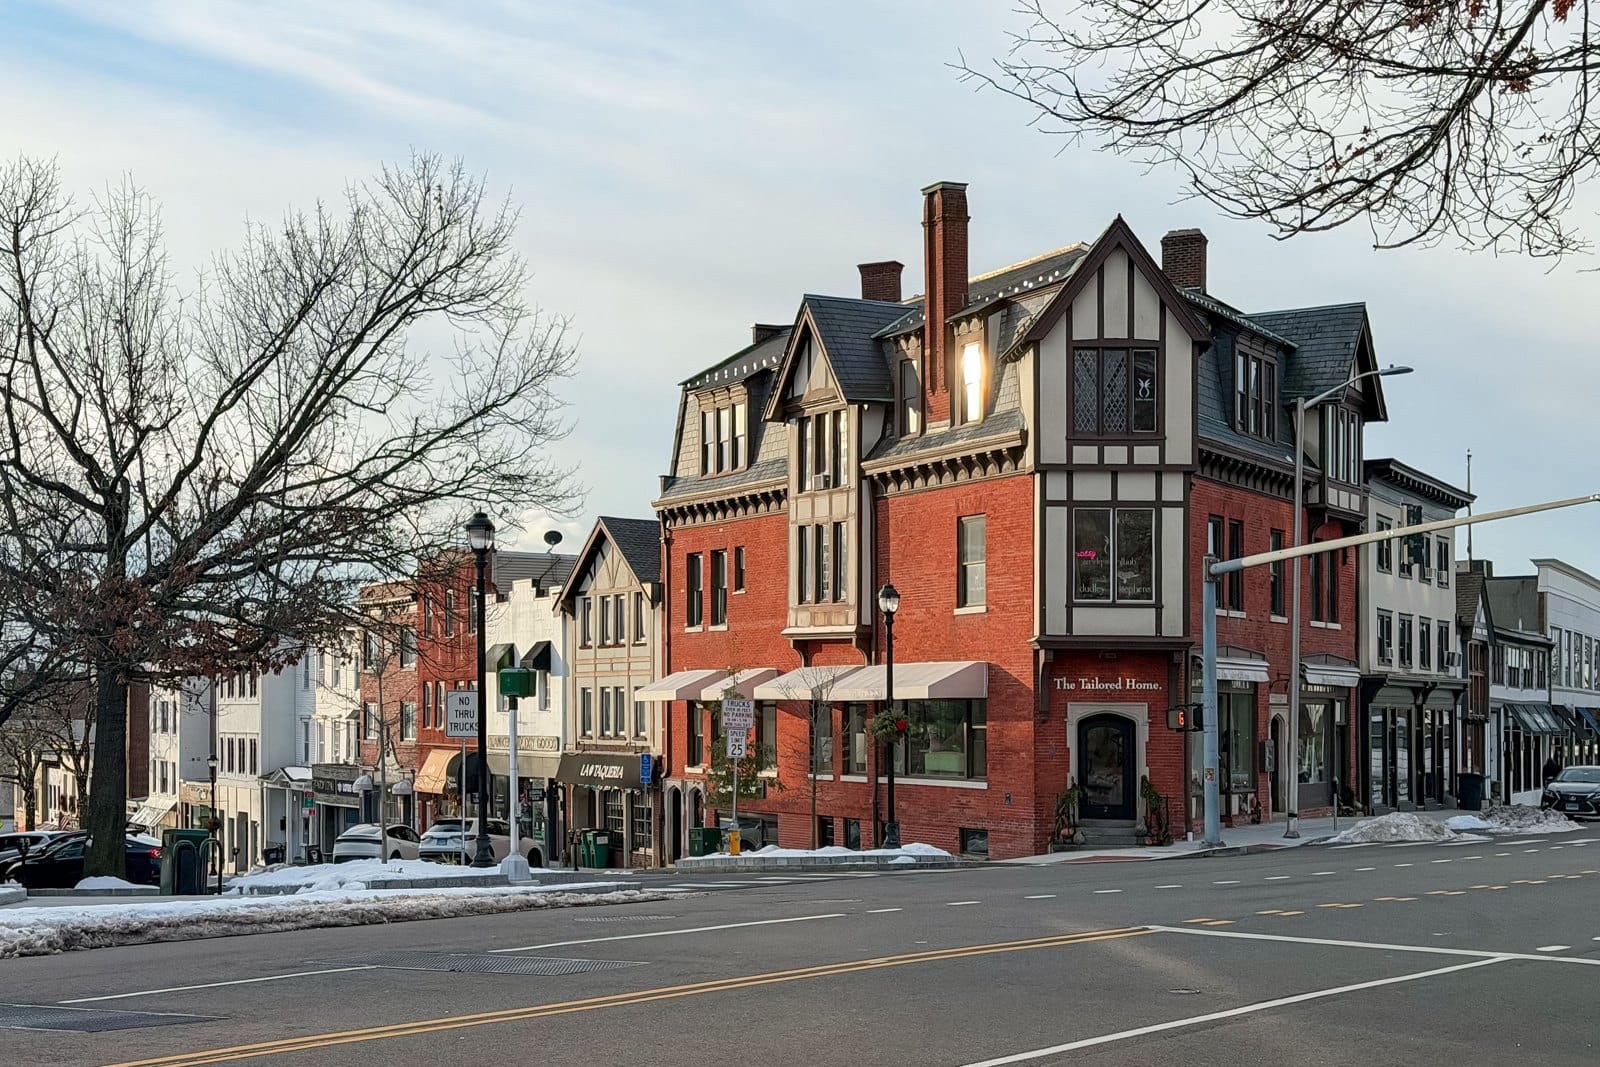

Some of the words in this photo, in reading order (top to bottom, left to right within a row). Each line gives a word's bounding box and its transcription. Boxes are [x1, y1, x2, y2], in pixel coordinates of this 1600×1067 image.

[1054, 676, 1076, 690] The
[1078, 676, 1122, 690] Tailored
[1125, 678, 1163, 690] Home.
[458, 696, 470, 706] NO
[726, 700, 751, 708] TRUCKS
[454, 709, 475, 719] THRU
[449, 722, 479, 732] TRUCKS
[731, 744, 743, 756] 25
[580, 764, 589, 777] LA
[593, 764, 624, 780] TAQUERIA
